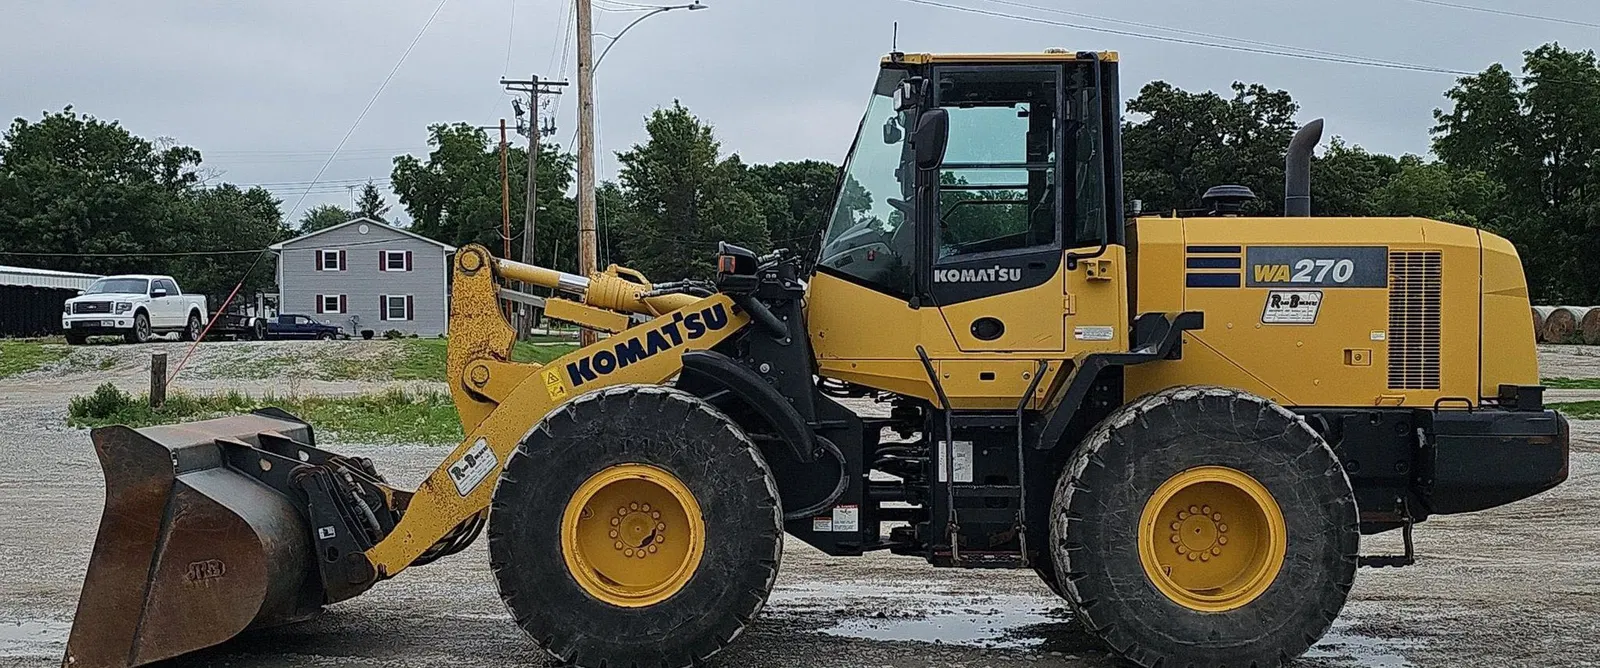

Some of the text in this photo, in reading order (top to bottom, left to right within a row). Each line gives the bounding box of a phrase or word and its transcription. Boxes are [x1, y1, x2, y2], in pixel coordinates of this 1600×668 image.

[934, 265, 1021, 282] KOMATSU
[1254, 258, 1354, 283] WA270
[566, 302, 728, 387] KOMATSU
